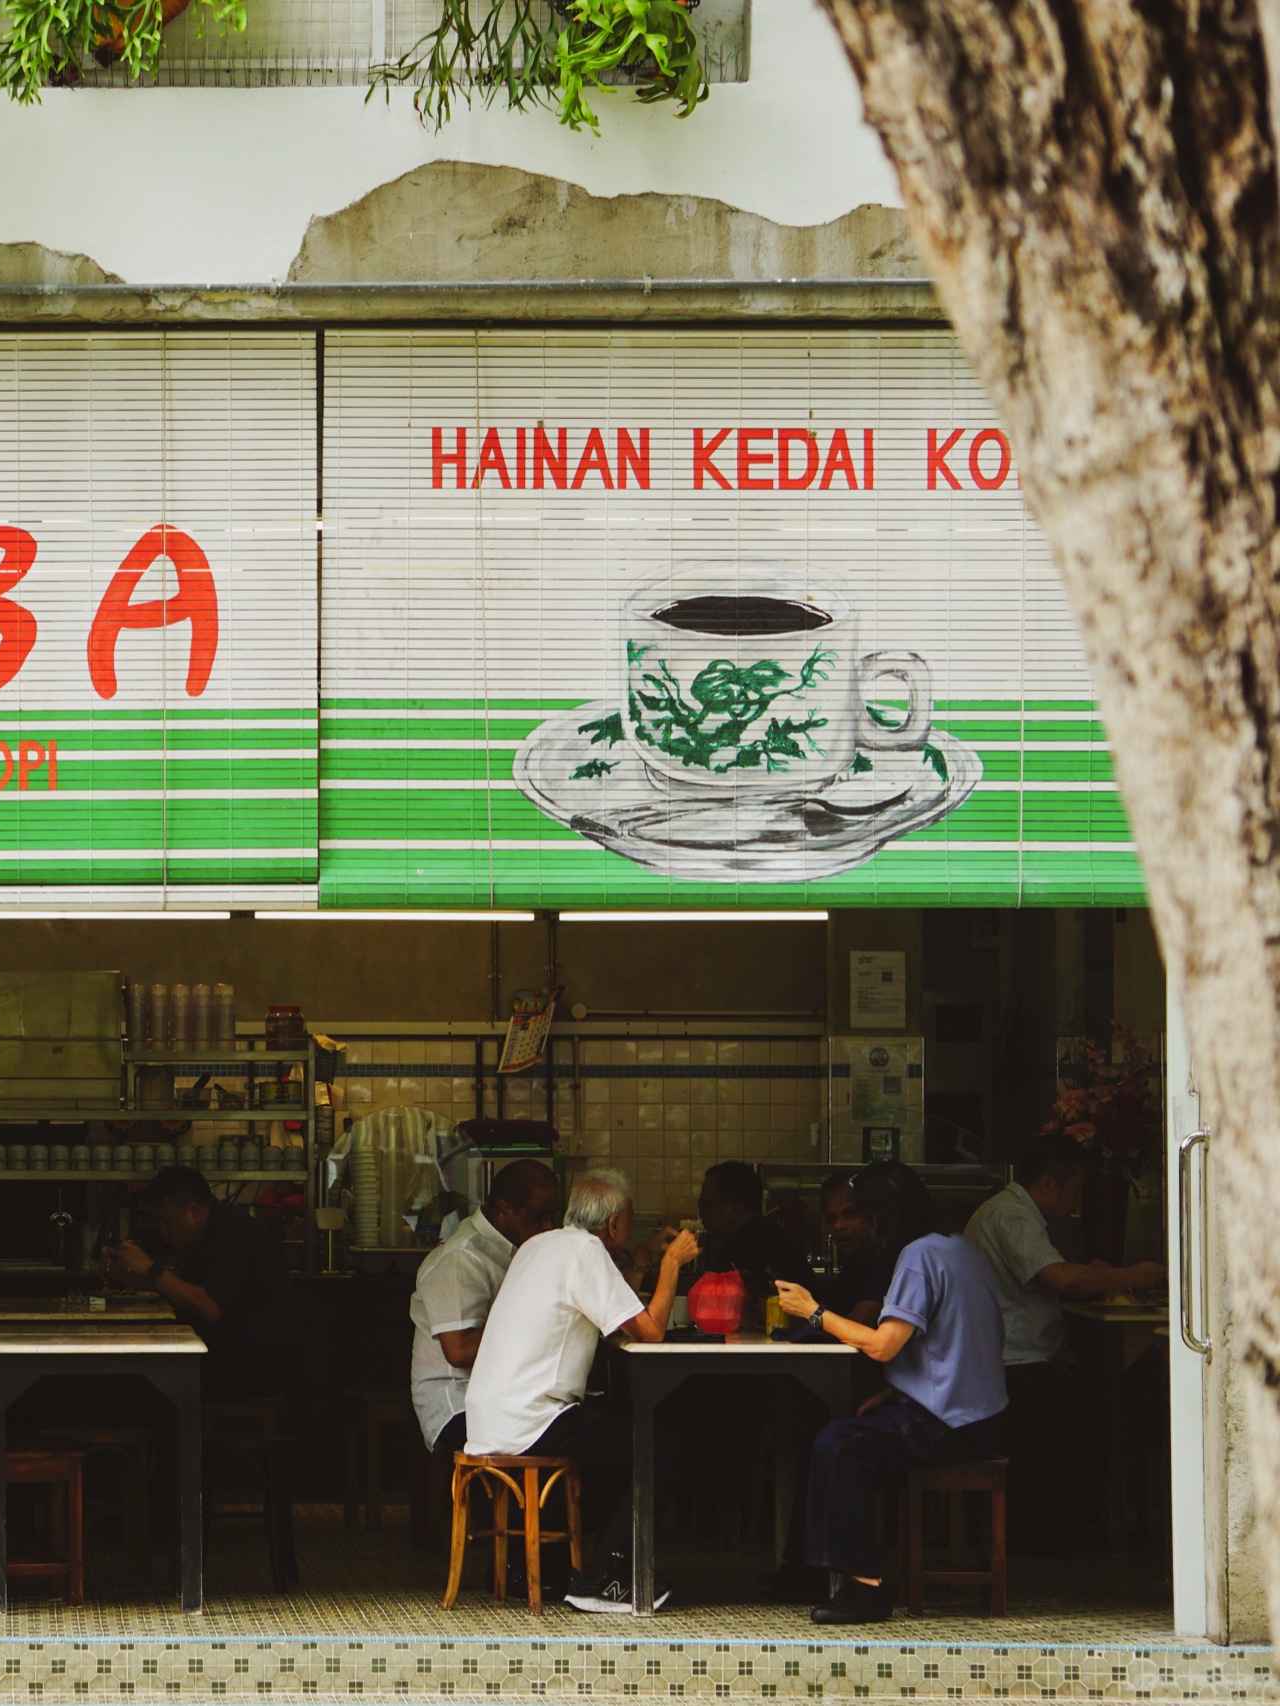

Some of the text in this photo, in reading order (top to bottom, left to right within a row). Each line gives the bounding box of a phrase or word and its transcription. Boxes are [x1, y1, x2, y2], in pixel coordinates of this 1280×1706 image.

[431, 427, 1023, 490] HAINAN KEDAI KO
